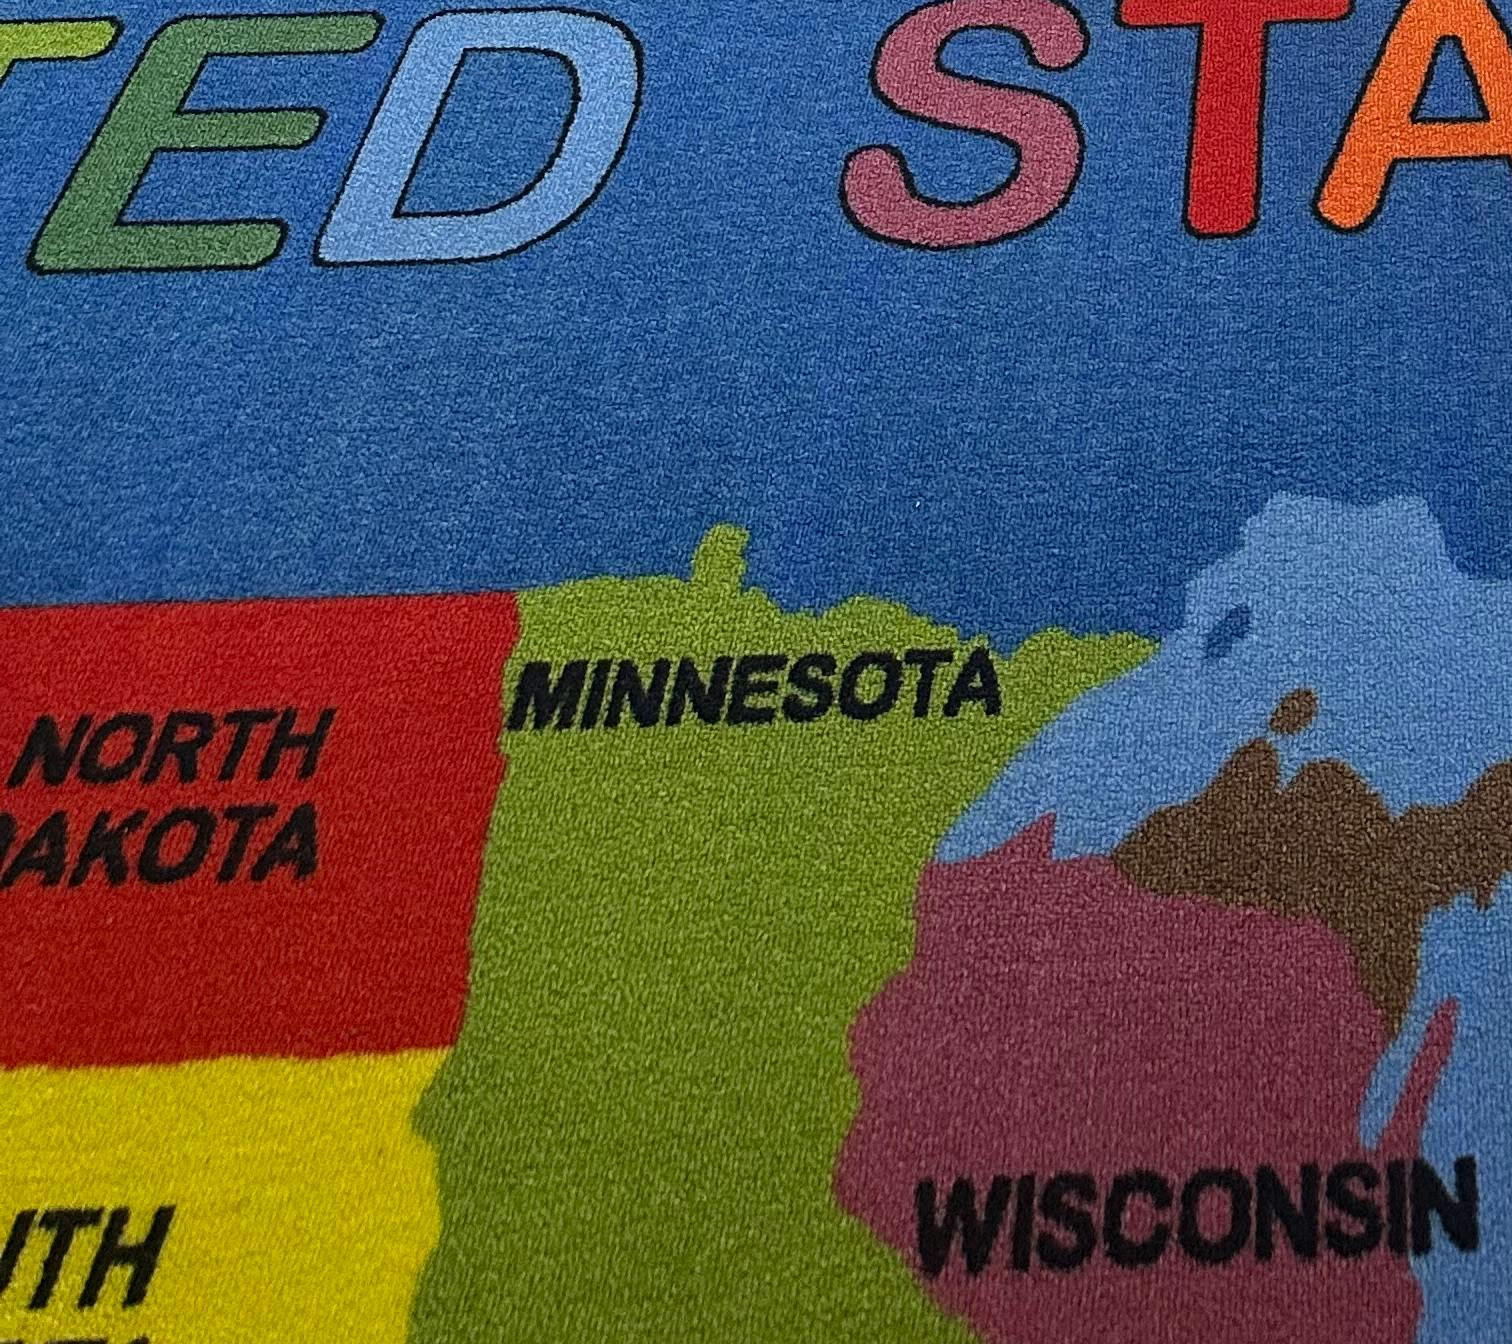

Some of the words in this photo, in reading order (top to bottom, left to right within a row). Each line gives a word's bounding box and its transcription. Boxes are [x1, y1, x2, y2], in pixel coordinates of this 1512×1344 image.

[507, 648, 1004, 731] MINNESOTA
[8, 708, 337, 789] NORTH
[0, 801, 319, 890] AKOTA
[915, 1156, 1480, 1277] WISCONSIN
